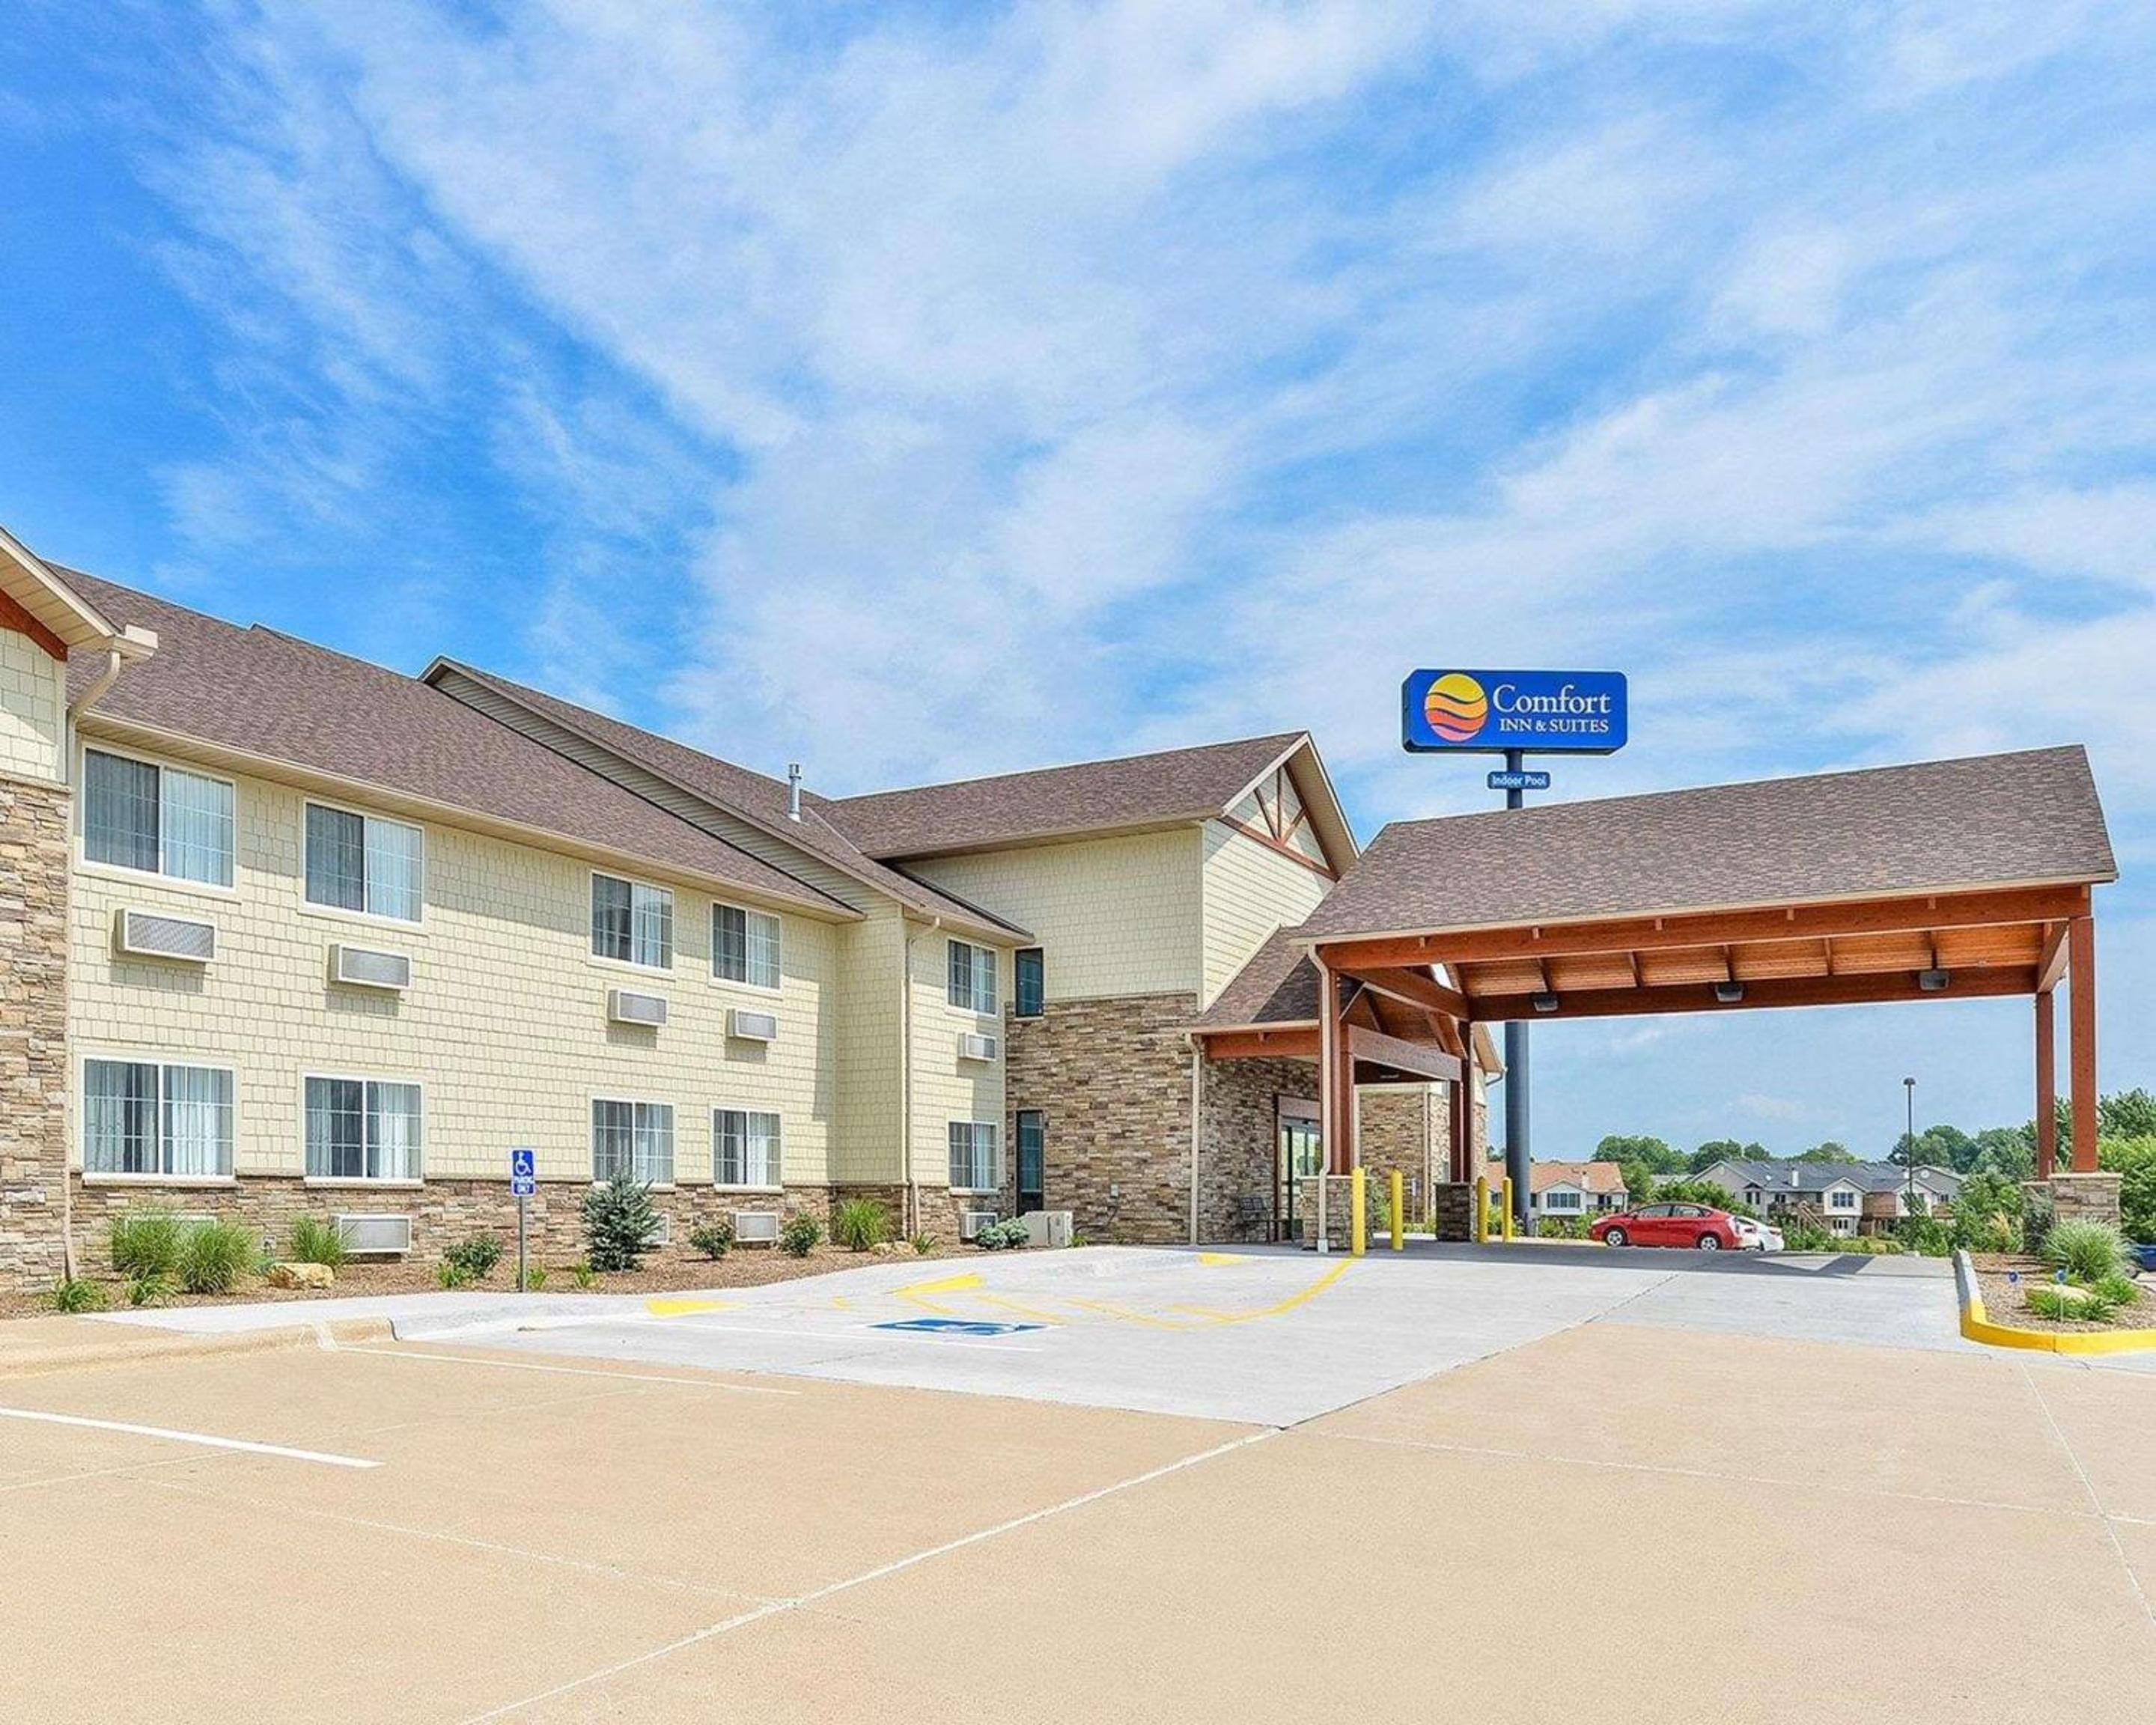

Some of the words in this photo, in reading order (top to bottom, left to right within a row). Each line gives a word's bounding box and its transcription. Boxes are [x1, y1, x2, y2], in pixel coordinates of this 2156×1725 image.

[1493, 684, 1611, 714] Comfort
[1499, 718, 1532, 732] INN
[1535, 719, 1547, 732] &
[1549, 719, 1609, 733] SUITES
